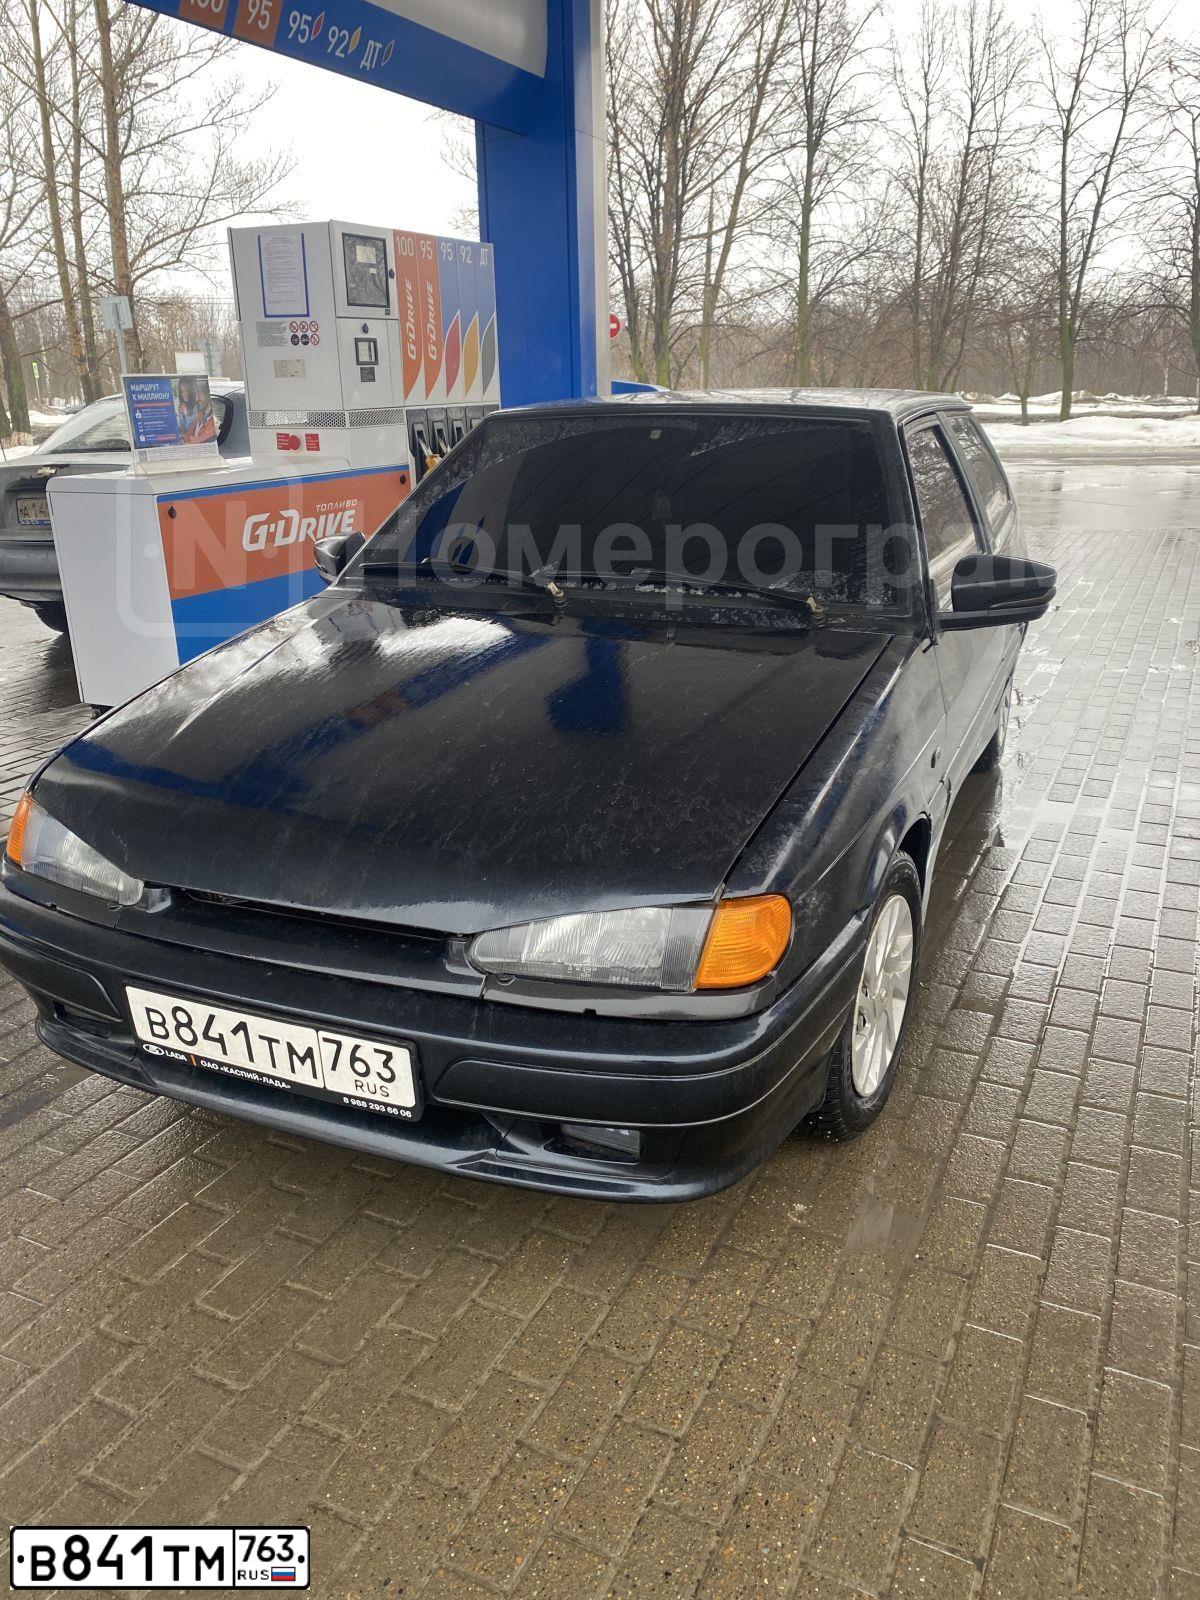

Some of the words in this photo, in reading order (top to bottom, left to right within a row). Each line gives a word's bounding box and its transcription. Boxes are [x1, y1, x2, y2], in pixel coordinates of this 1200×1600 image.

[247, 0, 272, 30] 95
[288, 10, 312, 44] 95
[326, 26, 350, 58] 92
[359, 40, 383, 71] ДТ
[396, 236, 414, 256] 100
[420, 240, 433, 260] 95
[441, 241, 453, 261] 95
[460, 245, 472, 264] 92
[480, 247, 489, 267] ДТ
[130, 383, 160, 392] МАРШРУТ
[137, 392, 170, 400] МИЛЛИОНУ
[315, 498, 358, 513] ТОПЛИВО
[144, 1005, 319, 1080] В841ТМ
[164, 1050, 188, 1062] LADA
[322, 1036, 397, 1084] 763
[200, 1060, 219, 1070] ОАО
[220, 1066, 292, 1089] «КАСПИЙ-ЛАДА»
[354, 1079, 390, 1098] RUS
[343, 1096, 349, 1104] 8
[350, 1098, 368, 1108] 988
[368, 1102, 386, 1112] 293
